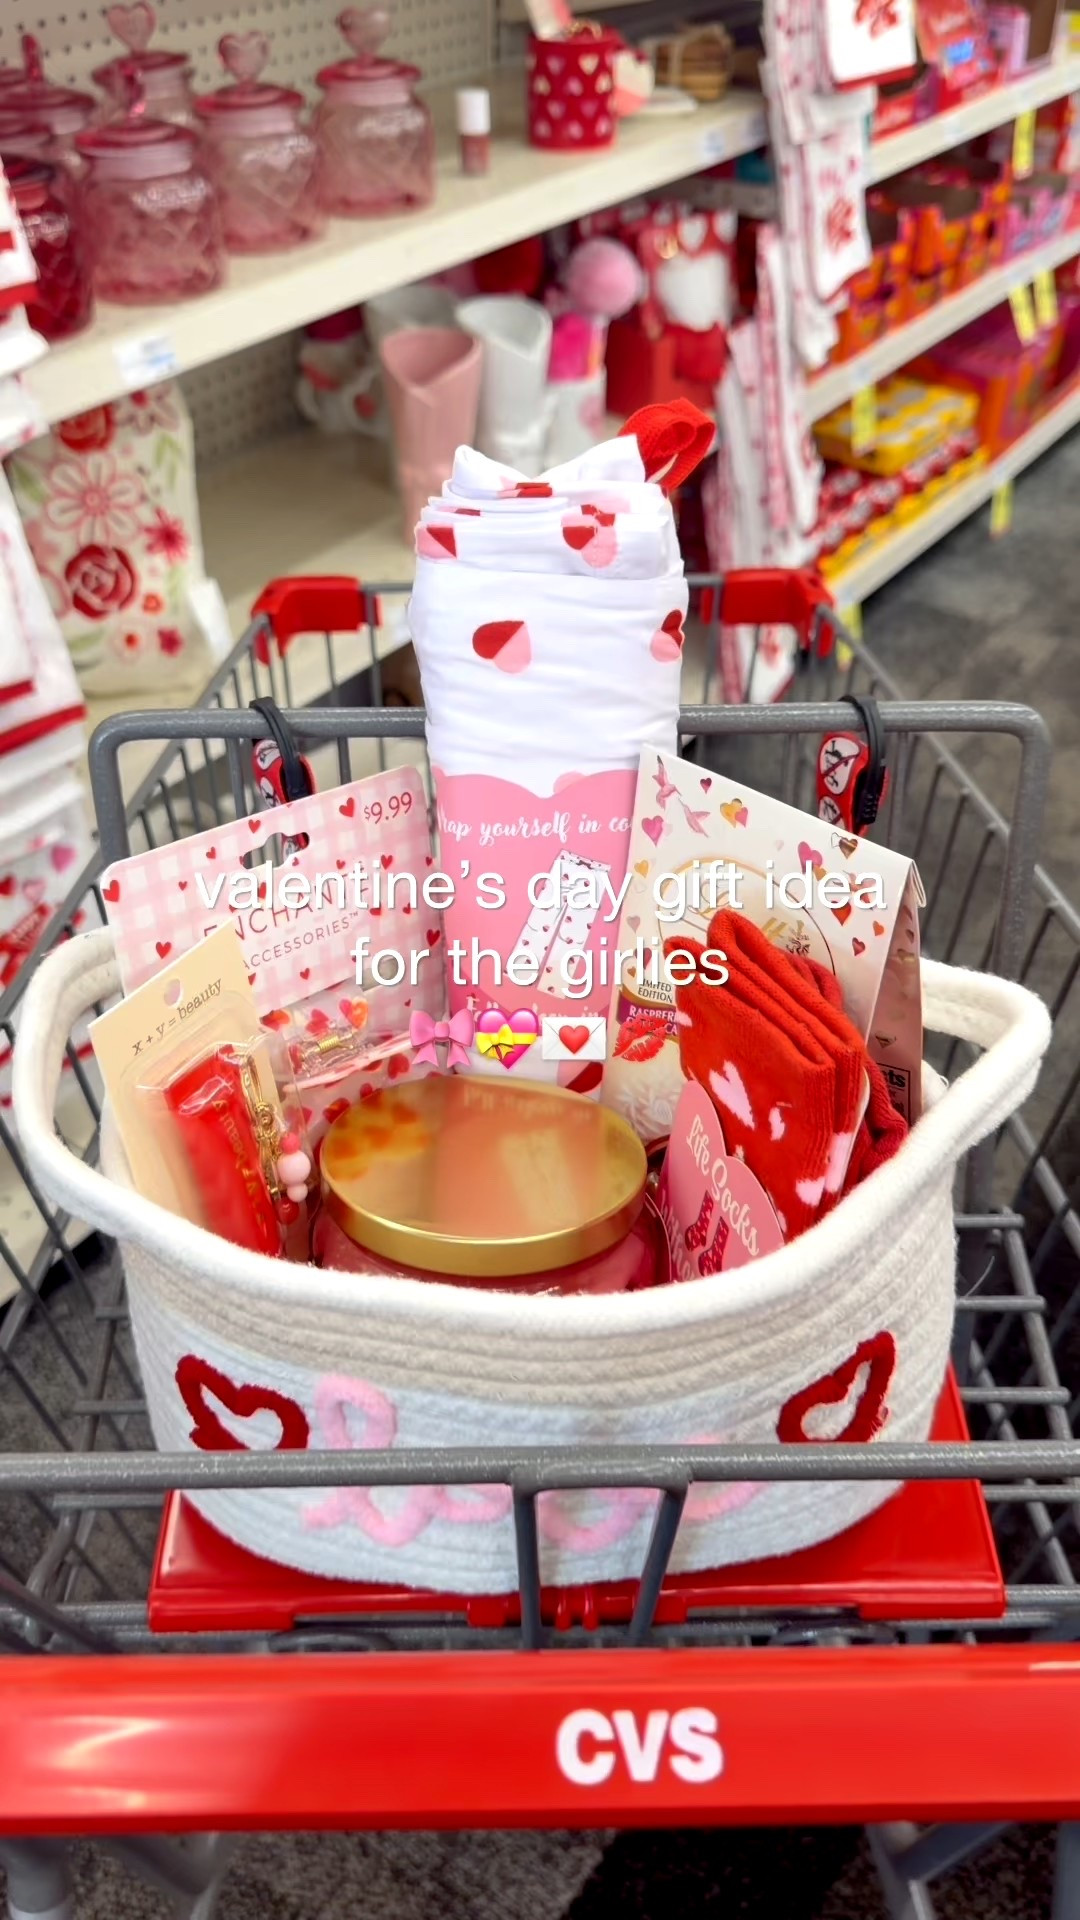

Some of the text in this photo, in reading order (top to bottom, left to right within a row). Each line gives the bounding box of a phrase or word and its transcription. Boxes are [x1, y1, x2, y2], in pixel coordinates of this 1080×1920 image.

[363, 791, 412, 825] $9.99
[479, 810, 571, 847] yourself
[578, 813, 602, 834] in
[608, 816, 632, 833] co
[132, 1040, 144, 1056] x
[155, 1022, 166, 1041] y
[177, 978, 221, 1020] beauty
[637, 987, 673, 1004] EDITION
[686, 1113, 760, 1257] Life Socks
[556, 1707, 724, 1785] CVS
